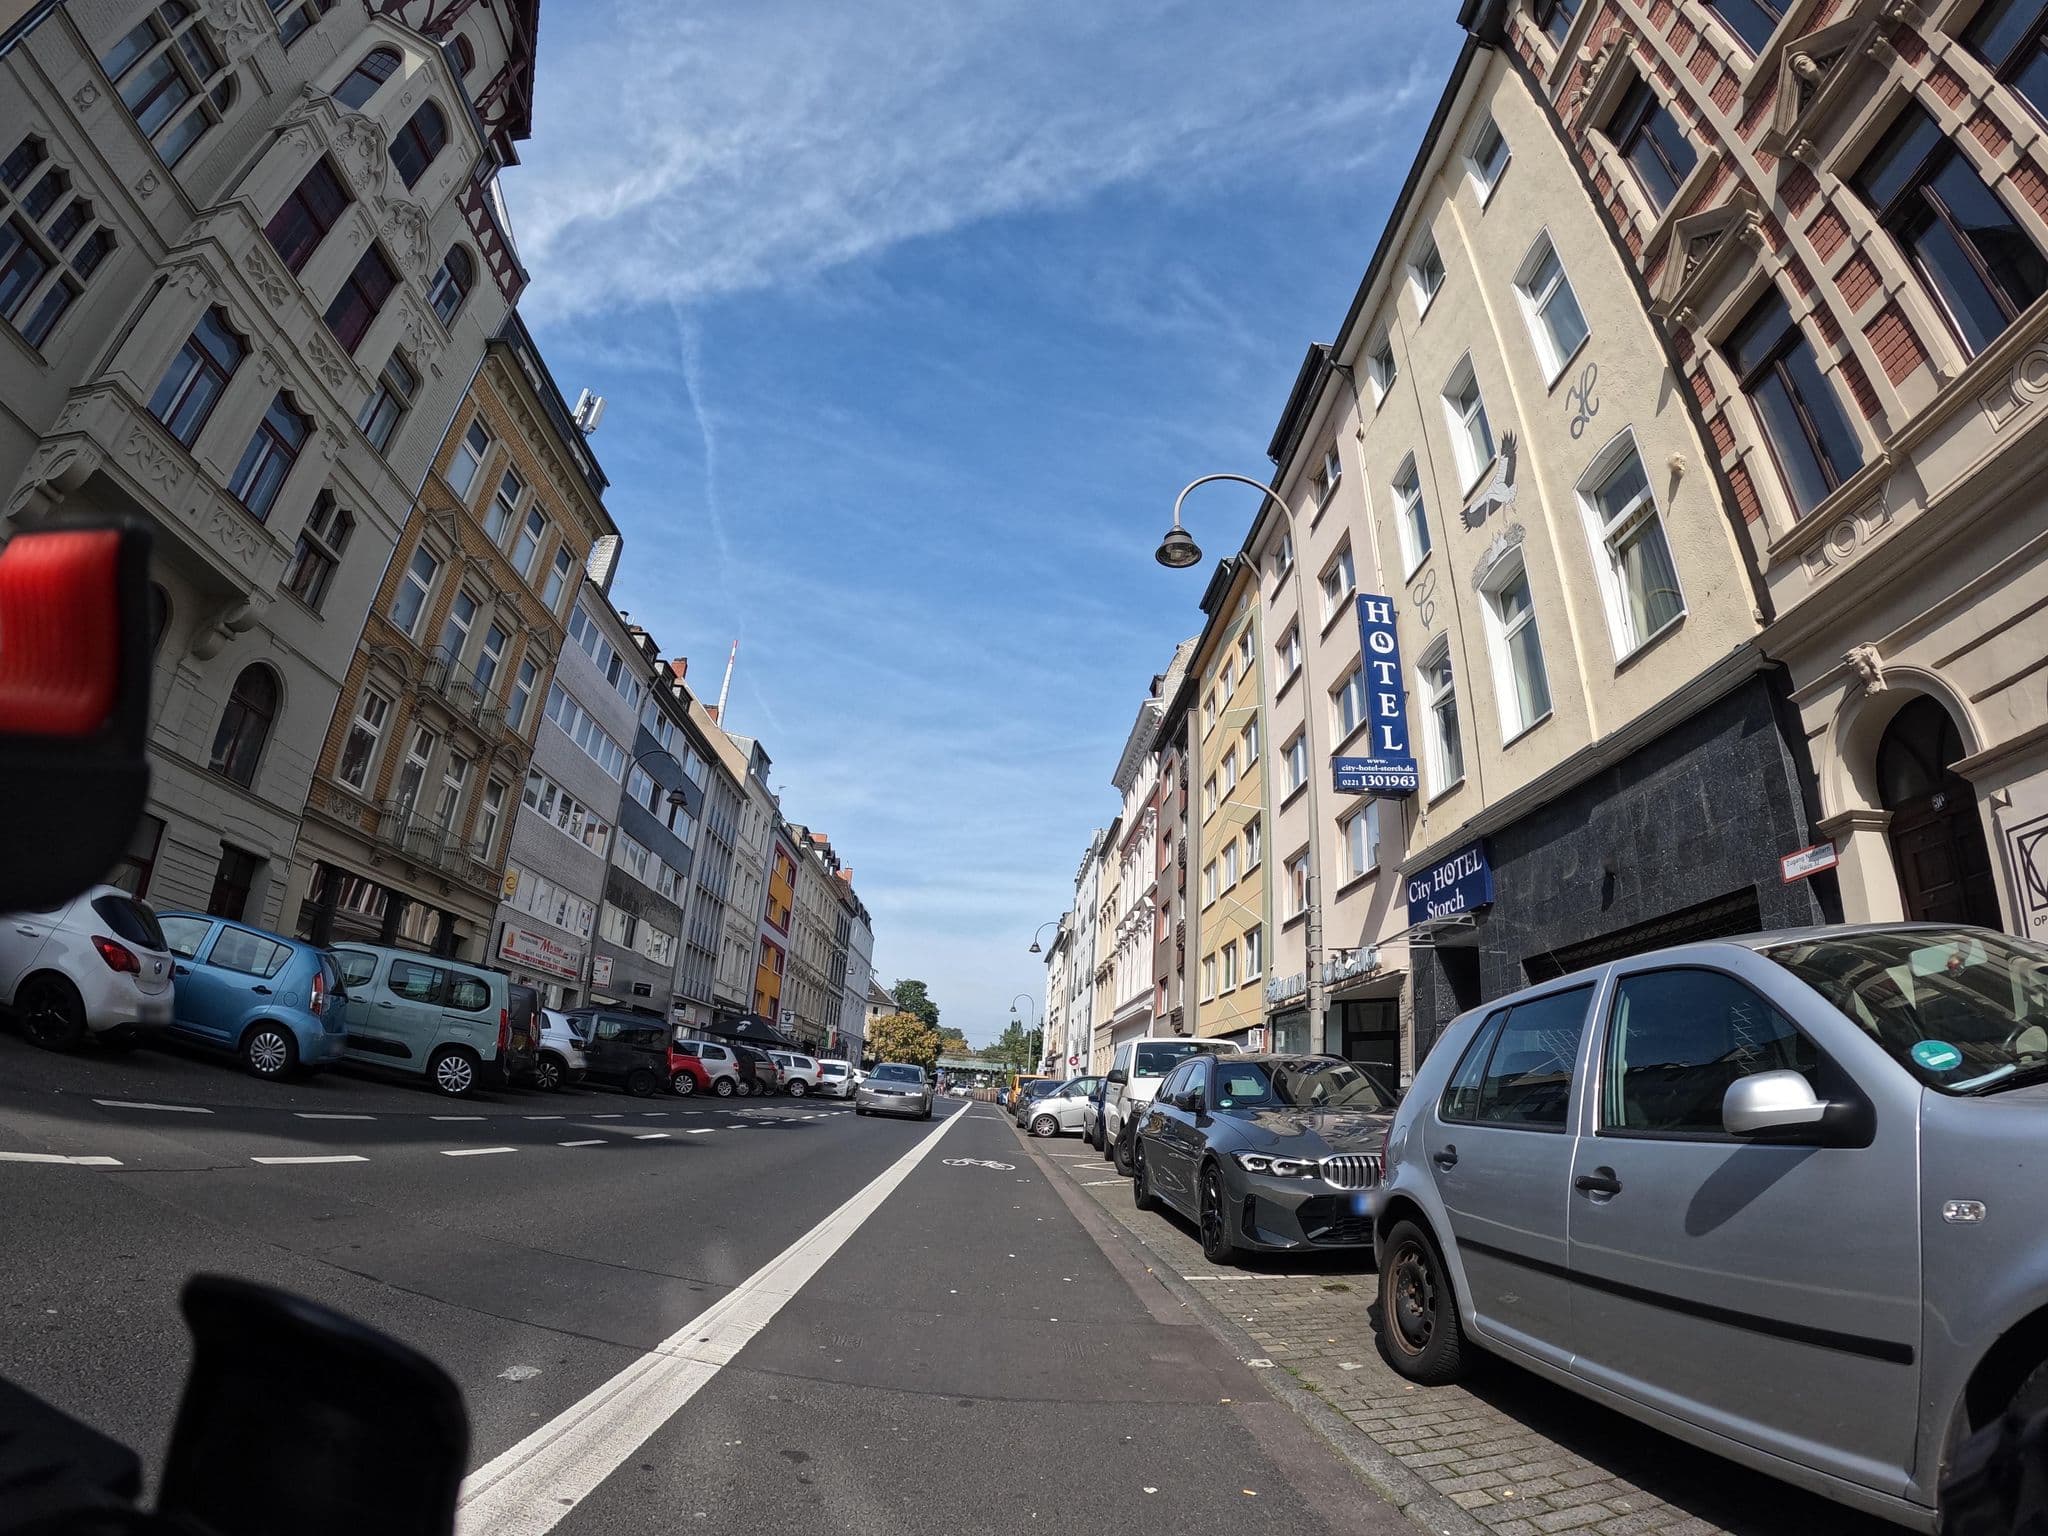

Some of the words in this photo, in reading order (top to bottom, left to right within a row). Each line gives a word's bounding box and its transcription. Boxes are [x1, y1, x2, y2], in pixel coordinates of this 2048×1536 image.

[1365, 600, 1403, 751] HOTEL
[1341, 764, 1414, 772] city-hotel-storch.de
[1361, 775, 1416, 787] 1301963
[1408, 879, 1431, 903] City
[1433, 849, 1483, 892] HOTEL
[1427, 888, 1465, 921] Storch
